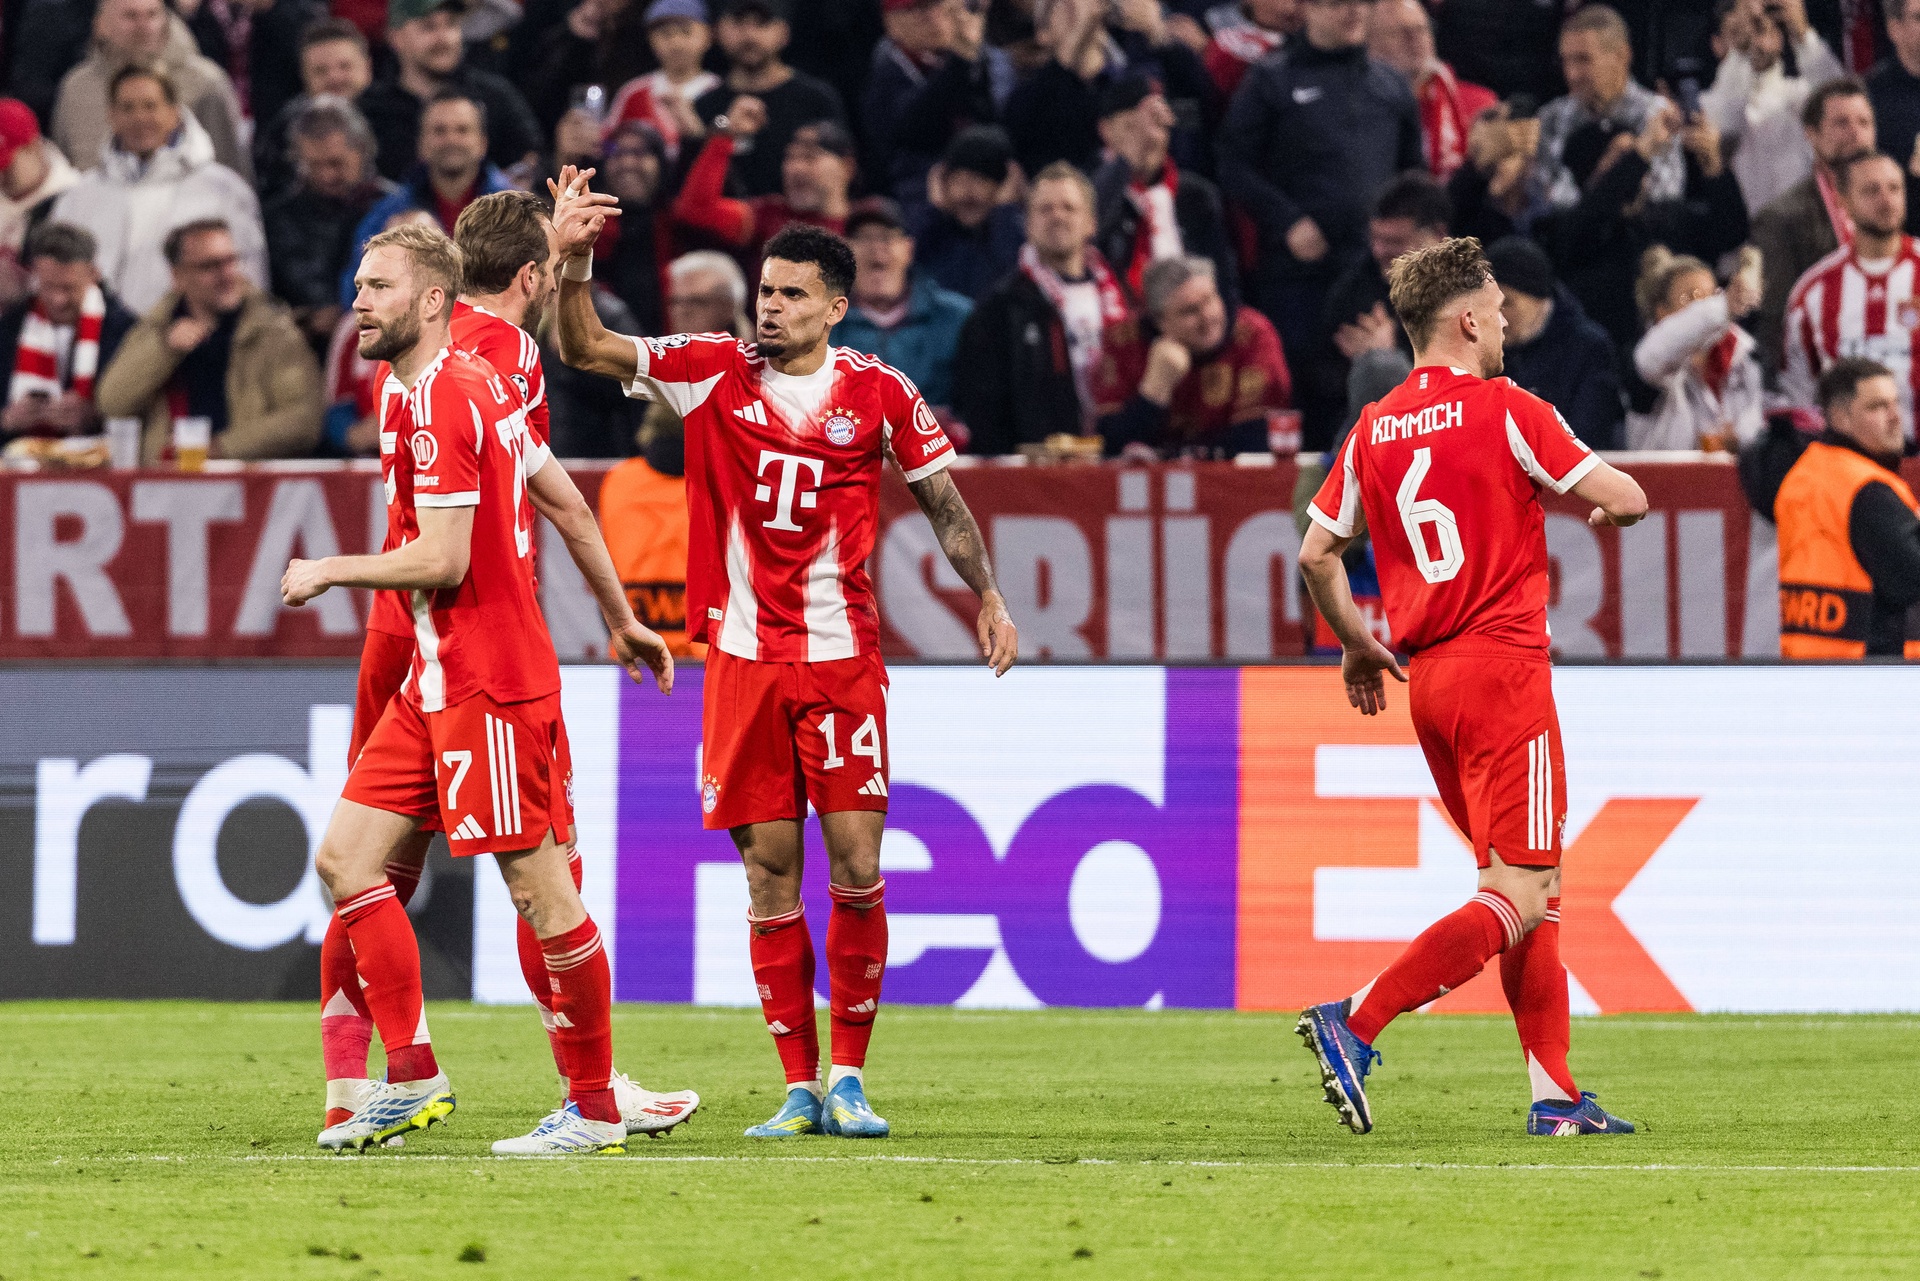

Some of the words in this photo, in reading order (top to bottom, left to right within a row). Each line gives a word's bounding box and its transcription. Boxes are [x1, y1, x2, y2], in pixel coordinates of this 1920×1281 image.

[1371, 401, 1463, 445] KIMMICH
[755, 450, 824, 532] T
[1395, 447, 1465, 584] 6
[15, 480, 390, 637] RTA
[817, 713, 882, 770] 14
[434, 750, 472, 810] 7
